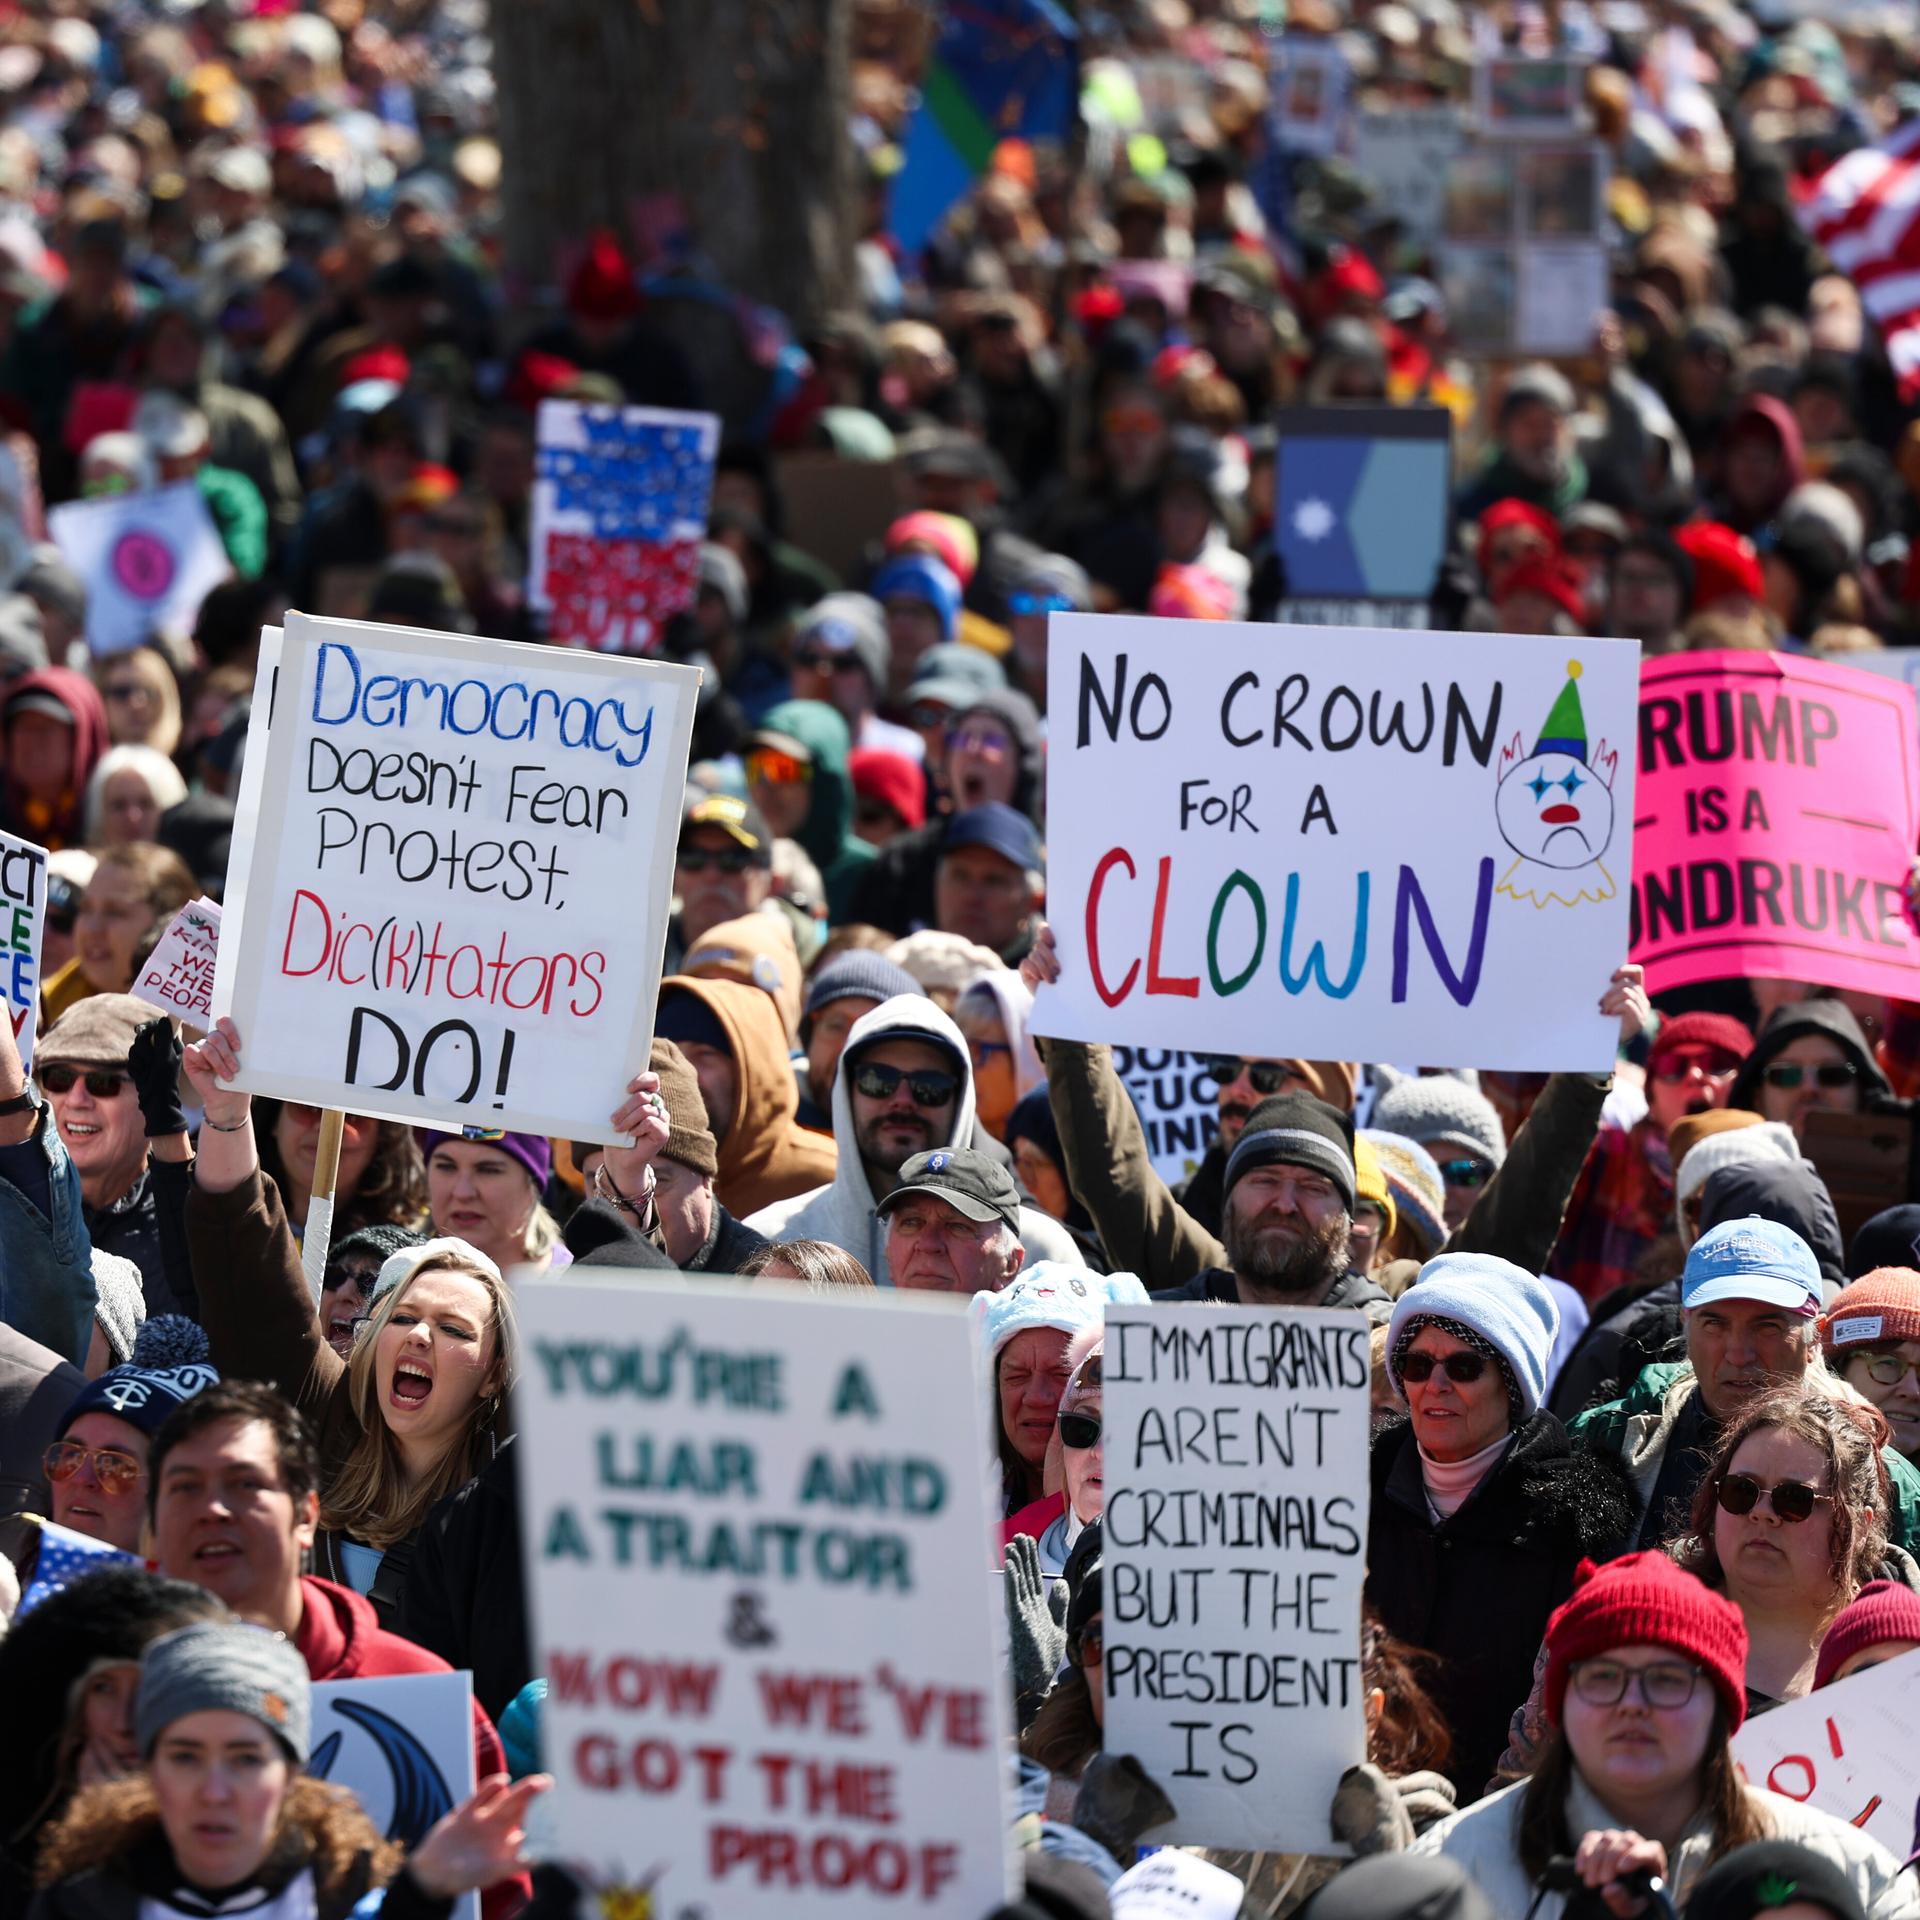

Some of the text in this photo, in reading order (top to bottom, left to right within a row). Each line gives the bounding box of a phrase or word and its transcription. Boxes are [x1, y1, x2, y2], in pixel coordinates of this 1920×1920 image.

[312, 643, 654, 766] Democracy
[1076, 652, 1502, 767] NO CROWN
[1638, 689, 1838, 774] RUMP
[308, 737, 482, 813] Doesn't
[506, 766, 628, 834] Fear
[1301, 784, 1338, 835] A
[1685, 788, 1770, 836] IS A
[317, 808, 569, 910] Protest,
[172, 926, 217, 958] KIN
[1085, 847, 1495, 1008] CLOWN
[144, 971, 211, 1017] PEOPL
[168, 962, 214, 997] THE
[344, 1006, 516, 1110] DO!
[832, 1362, 880, 1420] A
[1105, 1321, 1368, 1389] IMMIGRANTS
[1135, 1405, 1340, 1468] AREN'T
[596, 1432, 948, 1517] LIAR AND
[543, 1507, 912, 1594] A TRAITOR
[1107, 1488, 1361, 1556] CRIMINALS
[1113, 1563, 1341, 1635] BUT THE
[1106, 1645, 1359, 1709] PRESIDENT
[574, 1735, 901, 1824] GOT THE
[1170, 1720, 1259, 1785] IS
[709, 1825, 959, 1901] PROOF
